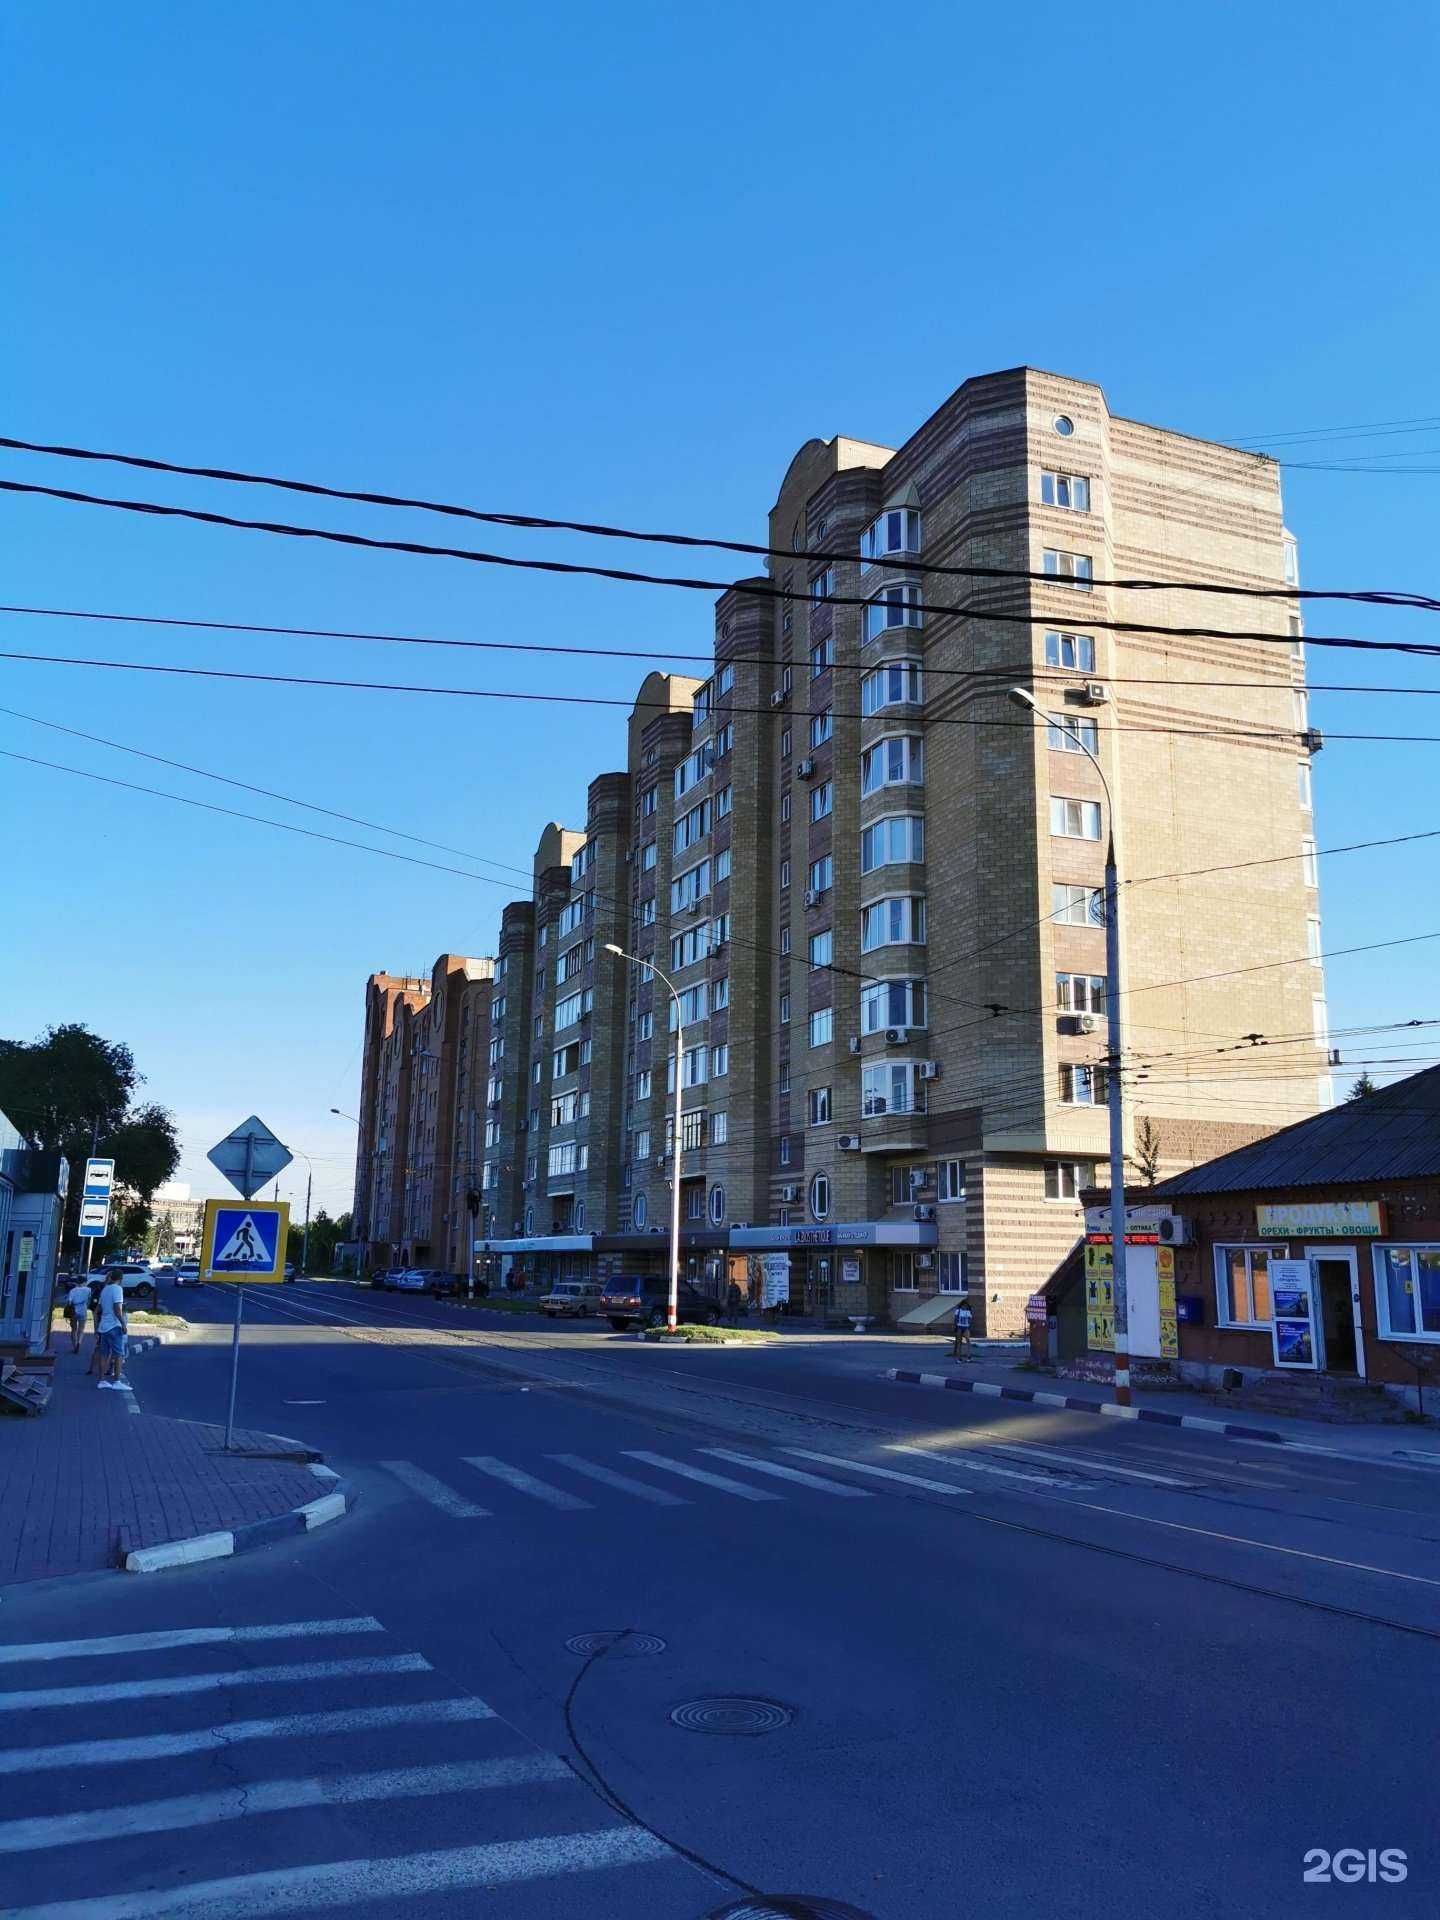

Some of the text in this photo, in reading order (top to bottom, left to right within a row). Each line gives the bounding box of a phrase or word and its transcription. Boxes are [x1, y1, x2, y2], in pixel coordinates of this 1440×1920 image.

[1264, 1203, 1369, 1225] ПРОДУКТЫ
[1261, 1225, 1379, 1235] ОРЕХИ ФРУКТЫ ОВОЩИ
